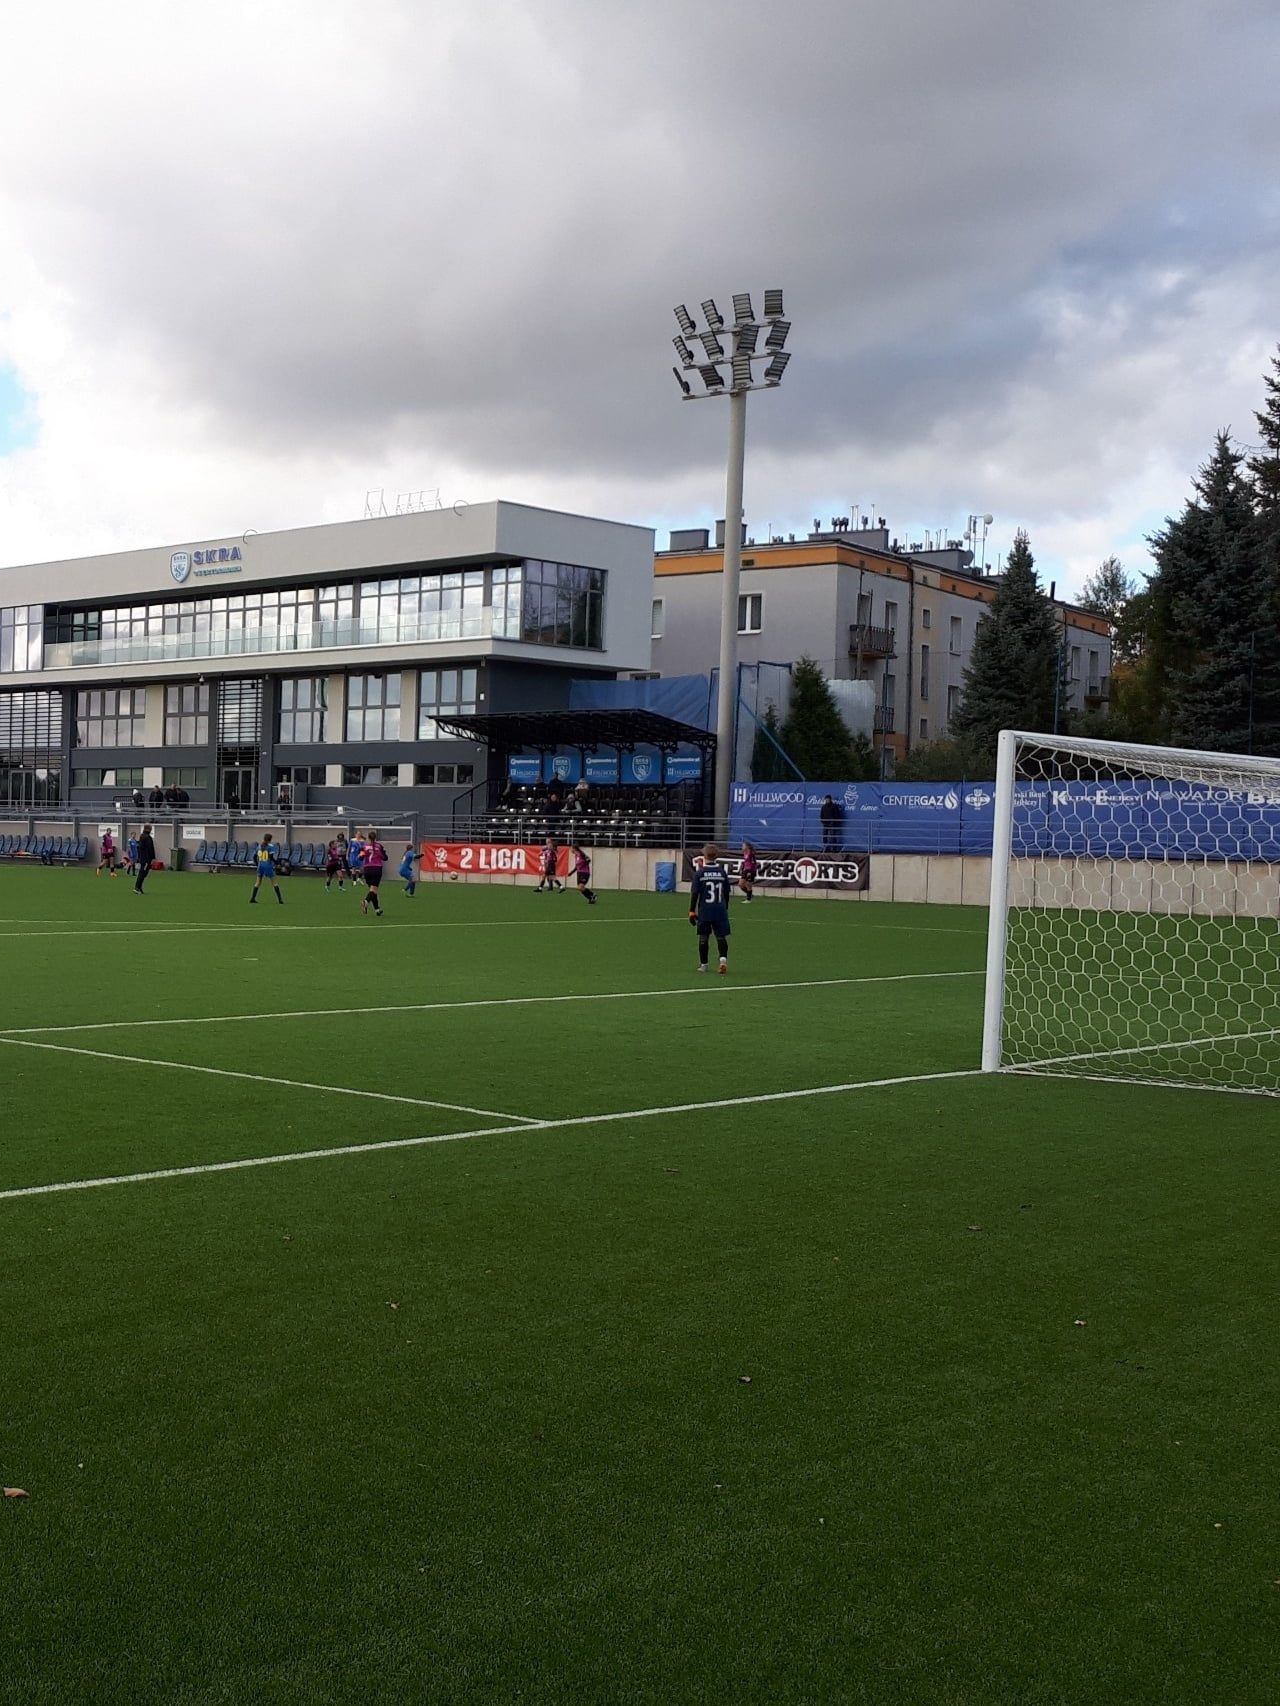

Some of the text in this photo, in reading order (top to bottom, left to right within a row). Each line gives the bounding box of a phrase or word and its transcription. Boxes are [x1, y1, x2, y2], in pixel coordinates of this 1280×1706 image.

[194, 547, 241, 565] SKRA
[749, 793, 804, 803] HILLWOOD
[882, 795, 944, 806] CENTERGAZ
[460, 848, 527, 870] 2 LIGA
[705, 881, 723, 904] 31
